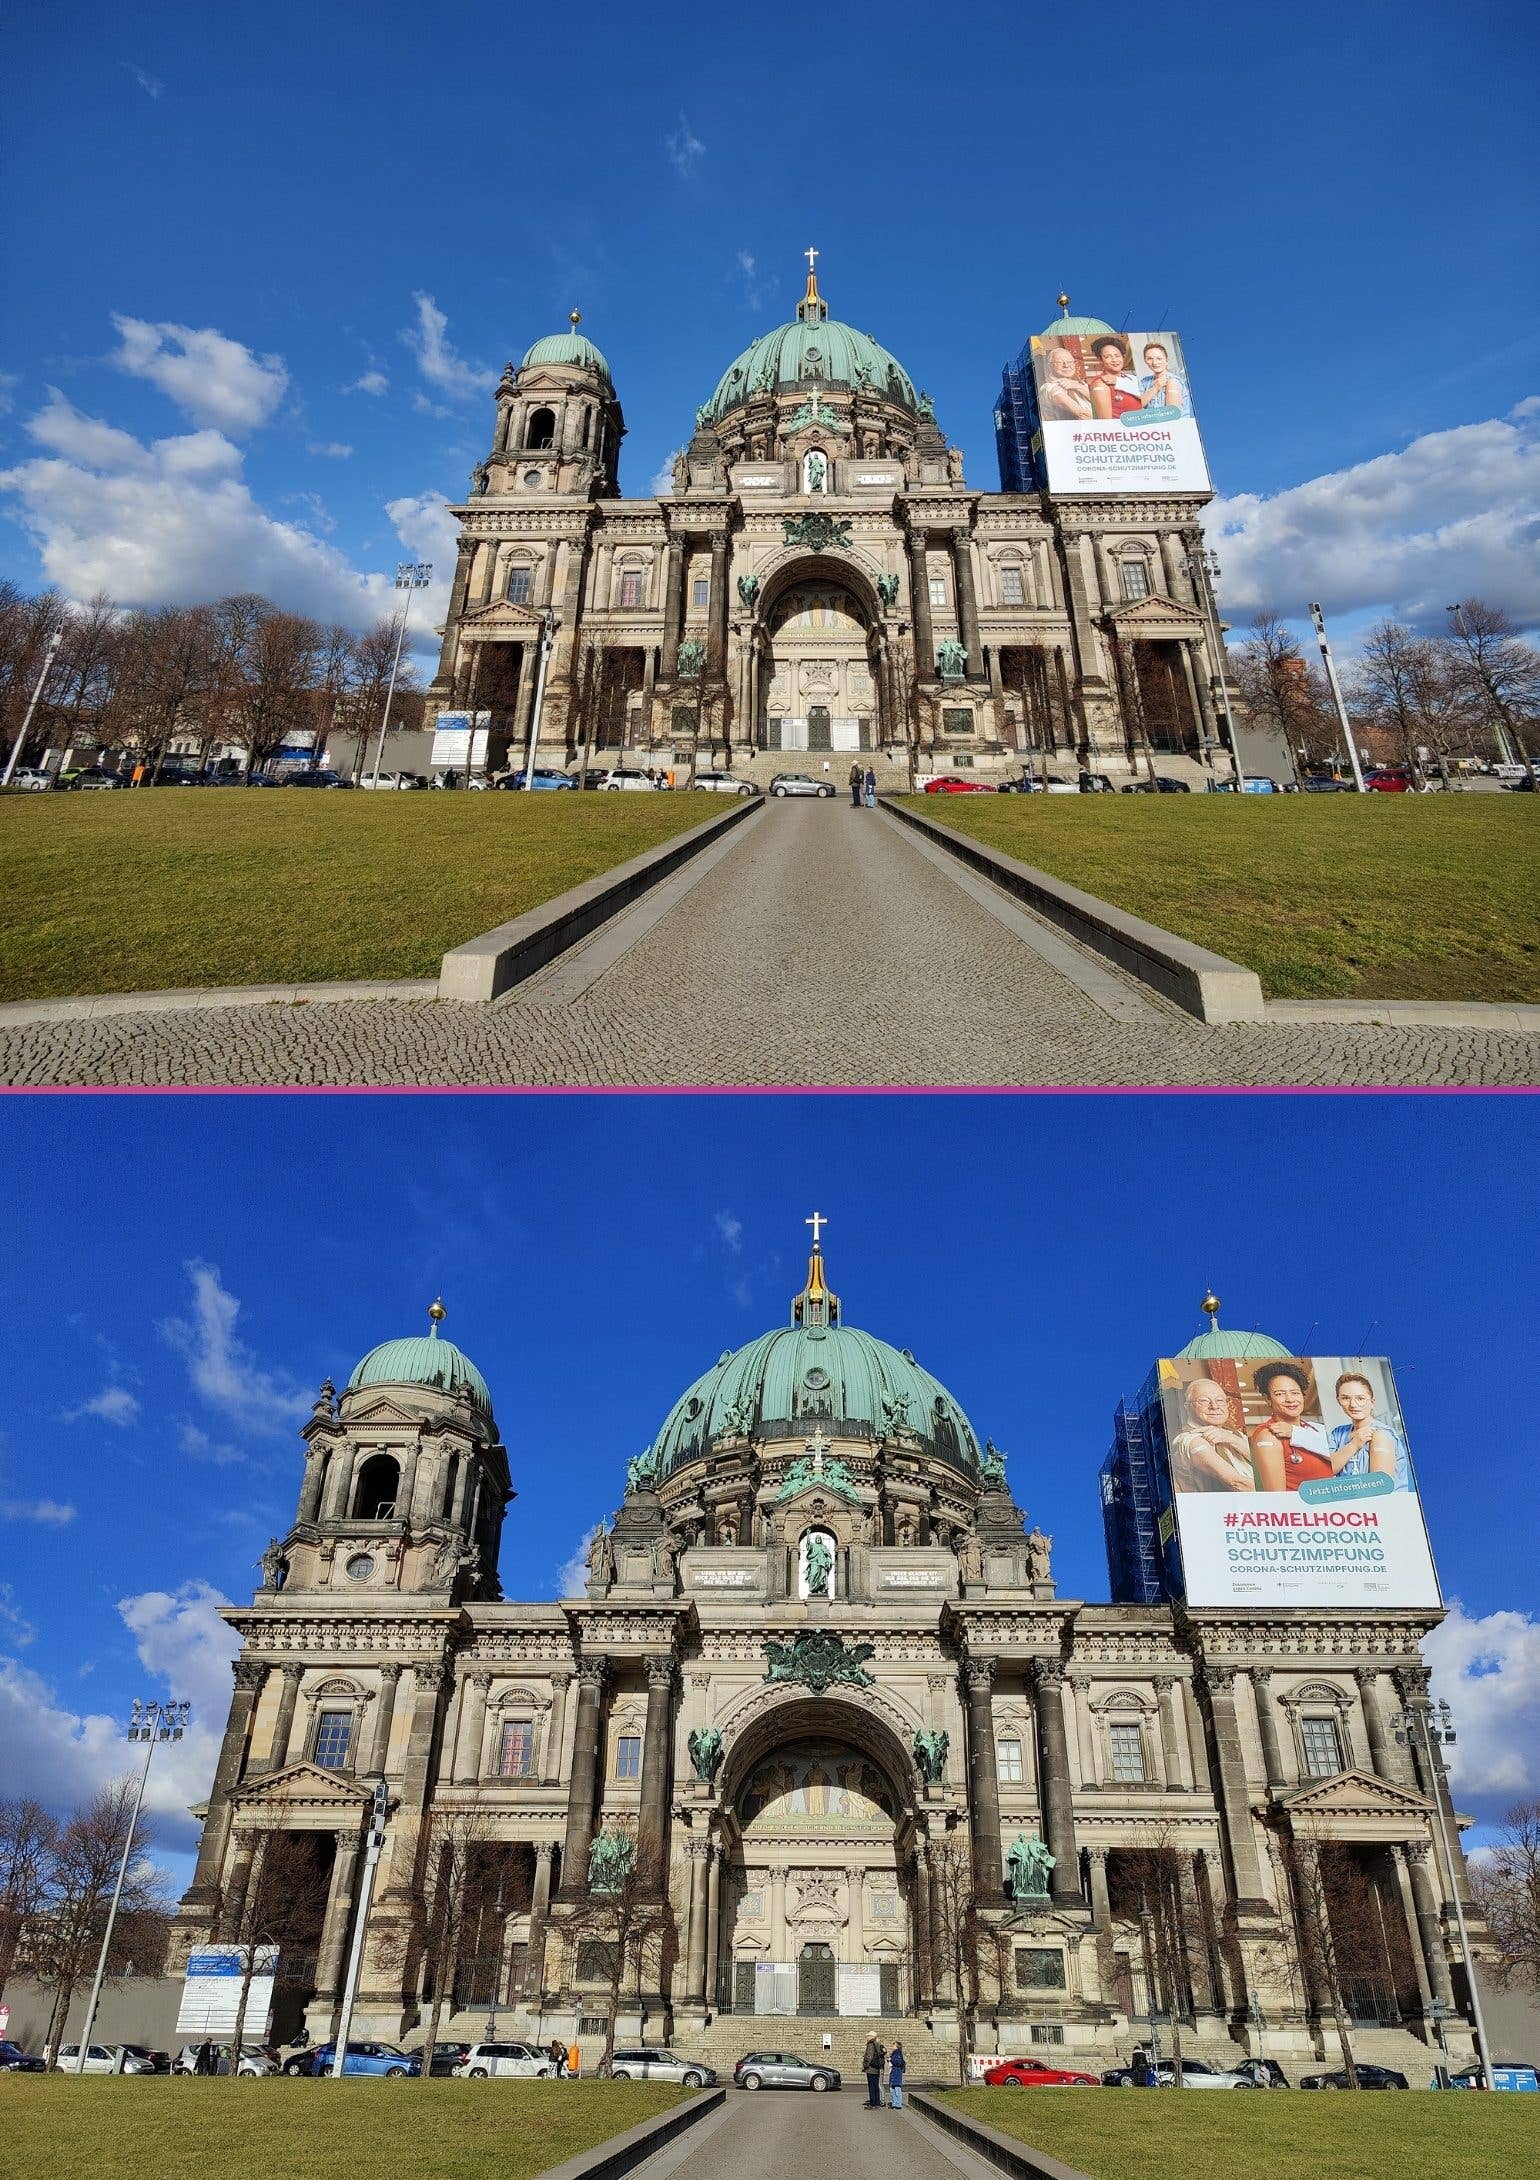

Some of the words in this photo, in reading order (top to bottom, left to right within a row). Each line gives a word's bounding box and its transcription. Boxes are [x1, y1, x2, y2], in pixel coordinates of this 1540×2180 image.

[1072, 431, 1172, 442] #ÄRMELHOCH
[1074, 443, 1097, 453] FÜR
[1099, 444, 1118, 453] DIE
[1120, 443, 1173, 452] CORONA
[1075, 454, 1176, 464] SCHUTZIMPFUNG
[1308, 1487, 1330, 1497] Jetzt
[1331, 1479, 1385, 1494] informieren!
[1224, 1512, 1379, 1527] #ÄRMELHOCH
[1225, 1528, 1261, 1544] FÜR
[1265, 1531, 1294, 1544] DIE
[1297, 1531, 1382, 1544] CORONA
[1228, 1548, 1385, 1561] SCHUTZIMPFUNG
[1229, 1565, 1387, 1573] CORONA-SCHUTZIMPFUNG.DE
